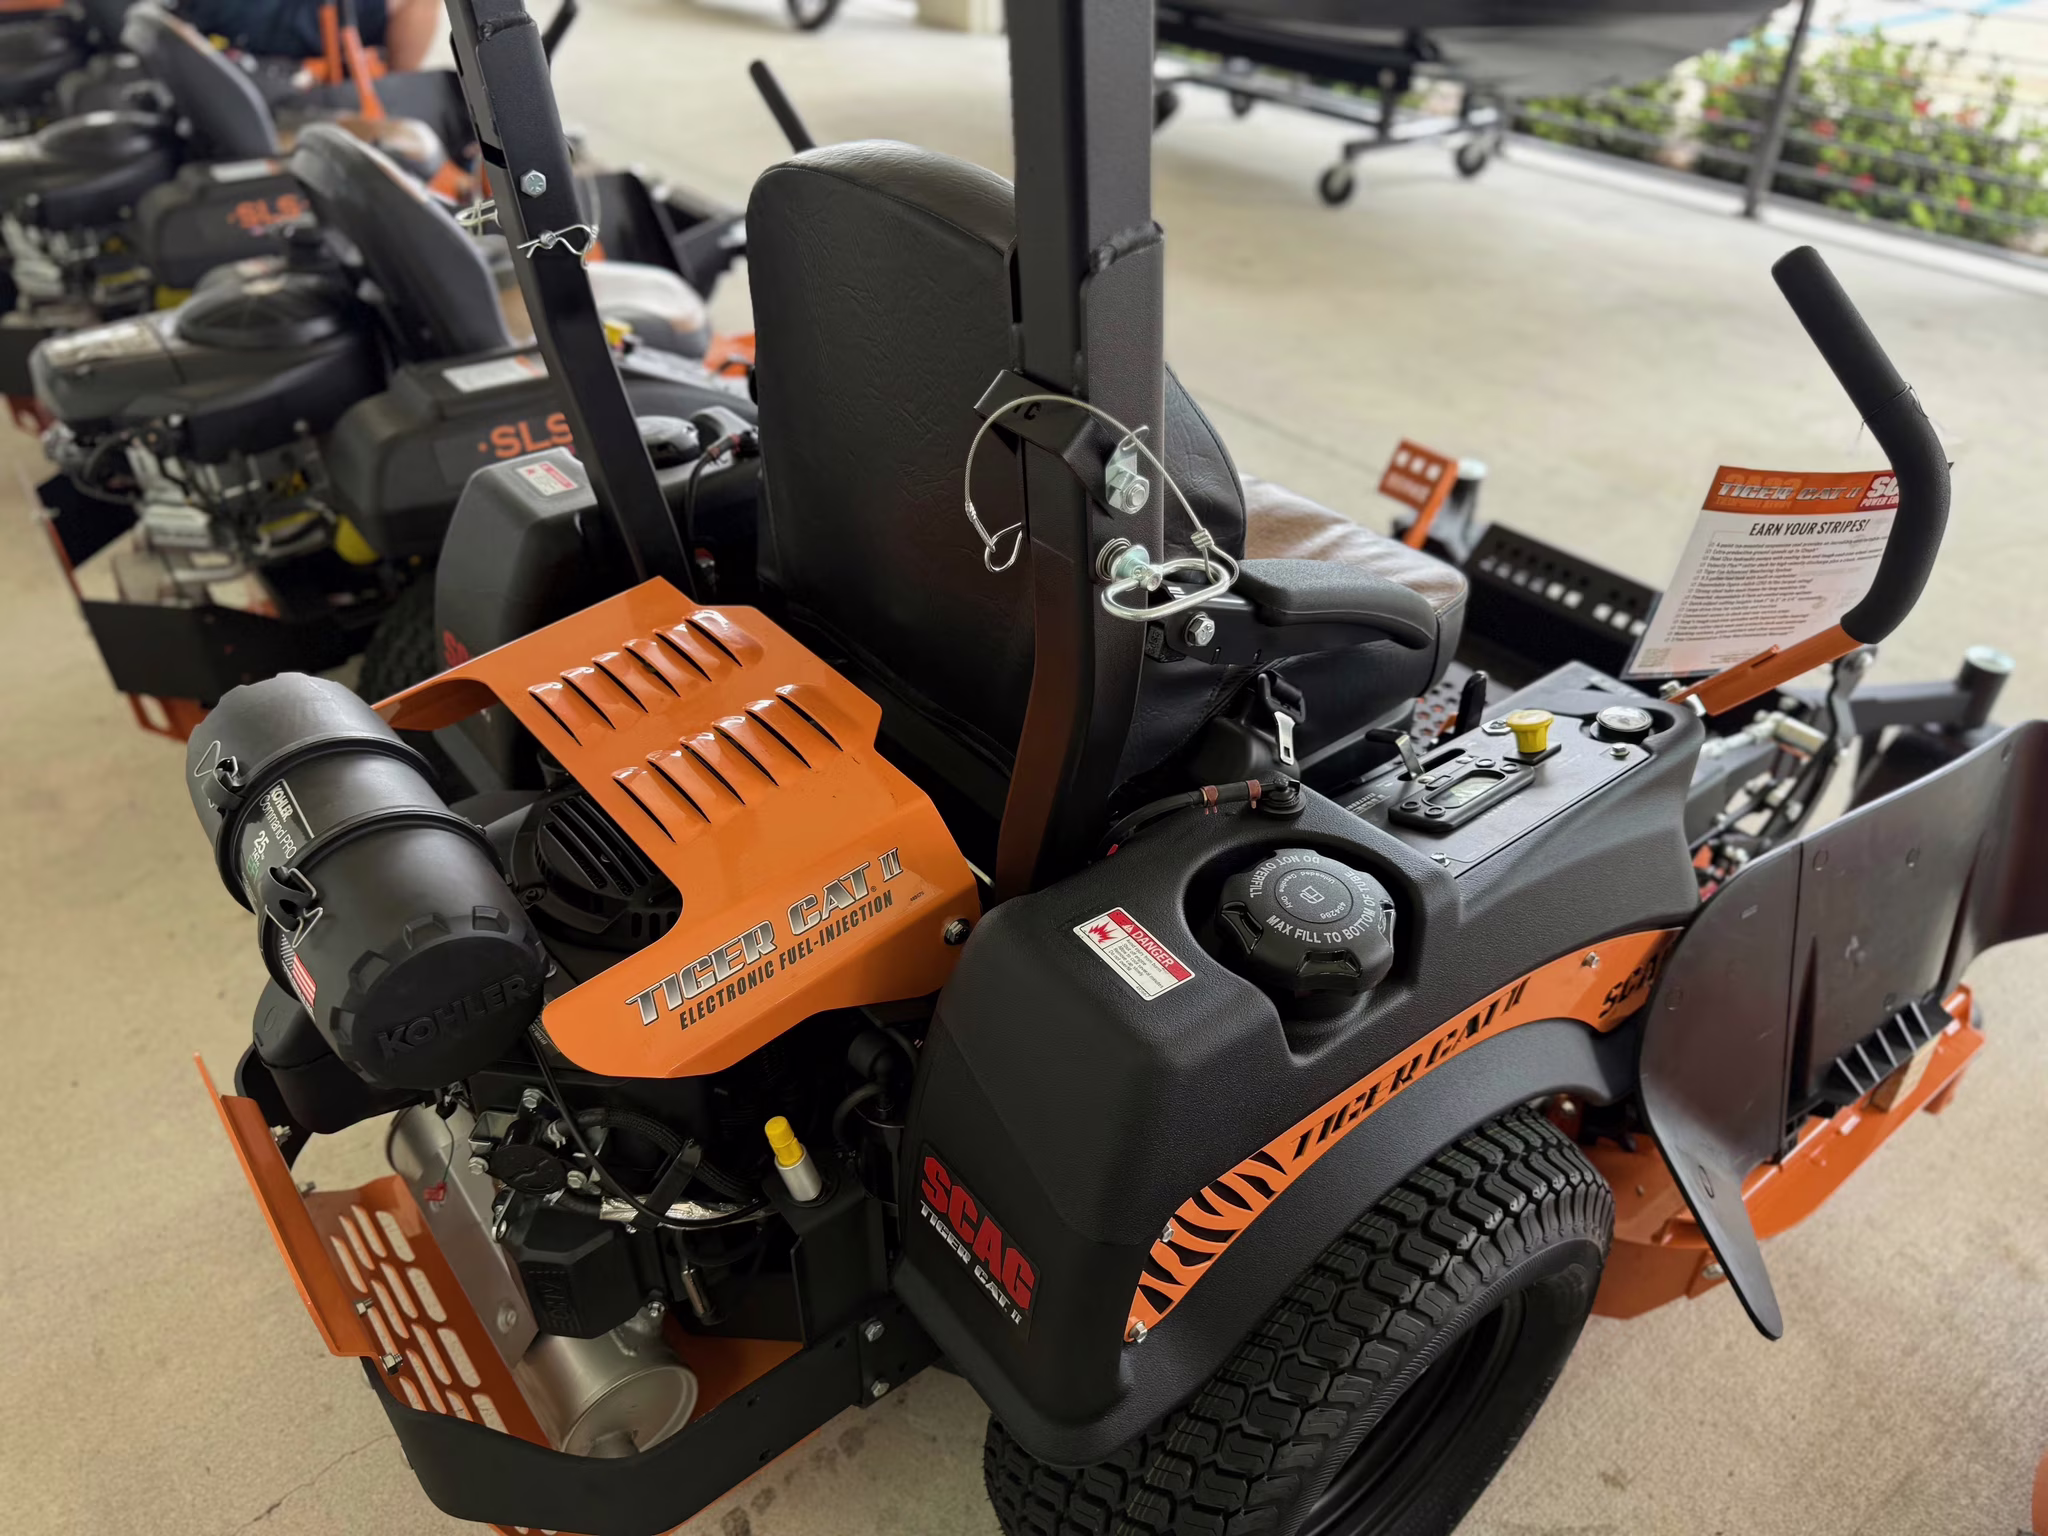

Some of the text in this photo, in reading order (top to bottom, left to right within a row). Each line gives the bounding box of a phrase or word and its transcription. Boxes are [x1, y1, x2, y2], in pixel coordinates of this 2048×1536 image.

[490, 411, 574, 459] SLS
[1717, 481, 1794, 500] TIGER
[1796, 487, 1847, 501] CAT
[1749, 519, 1872, 536] EARN YOUR STRIPES!
[254, 830, 270, 854] 25
[260, 794, 297, 859] Command PRO
[1250, 855, 1320, 898] DO NOT OVERFILL
[1266, 870, 1376, 944] MAX FILL TO BOTTOM OF TUBE
[1281, 895, 1294, 909] Only
[625, 920, 778, 1026] TIGER
[877, 847, 904, 883] II
[679, 889, 894, 1031] ELECTRONIC FUEL-INJECTION
[1133, 931, 1174, 968] DANGER
[1598, 953, 1658, 1018] SCA
[1290, 976, 1531, 1161] TIGER CAT II
[920, 1200, 972, 1265] TIGER
[1010, 1308, 1023, 1325] II
[921, 1156, 1035, 1310] SCAG
